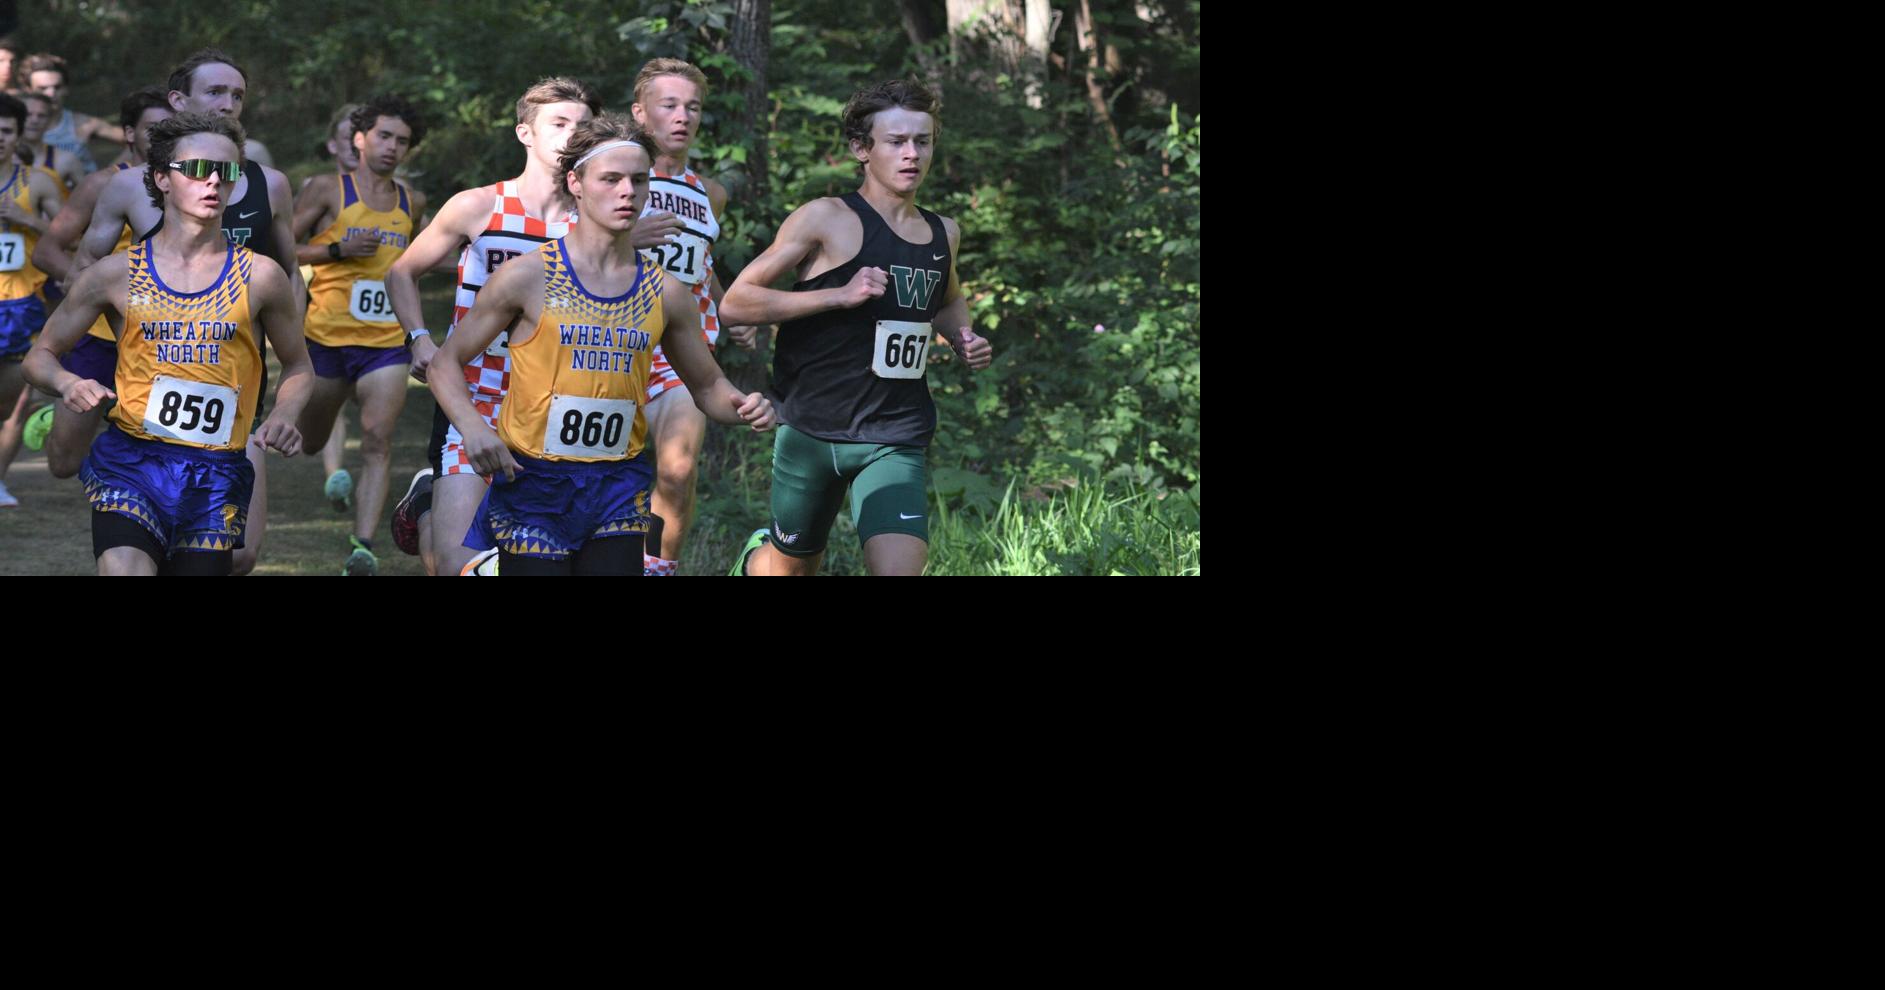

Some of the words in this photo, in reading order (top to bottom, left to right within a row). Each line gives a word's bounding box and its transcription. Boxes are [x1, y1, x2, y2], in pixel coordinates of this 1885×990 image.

[0, 242, 16, 265] 7
[889, 264, 942, 311] W
[358, 289, 393, 315] 69
[141, 321, 237, 341] WHEATON
[559, 323, 651, 353] WHEATON
[157, 344, 220, 363] NORTH
[571, 348, 633, 374] NORTH
[885, 333, 928, 370] 667
[158, 390, 225, 435] 859
[560, 409, 624, 448] 860
